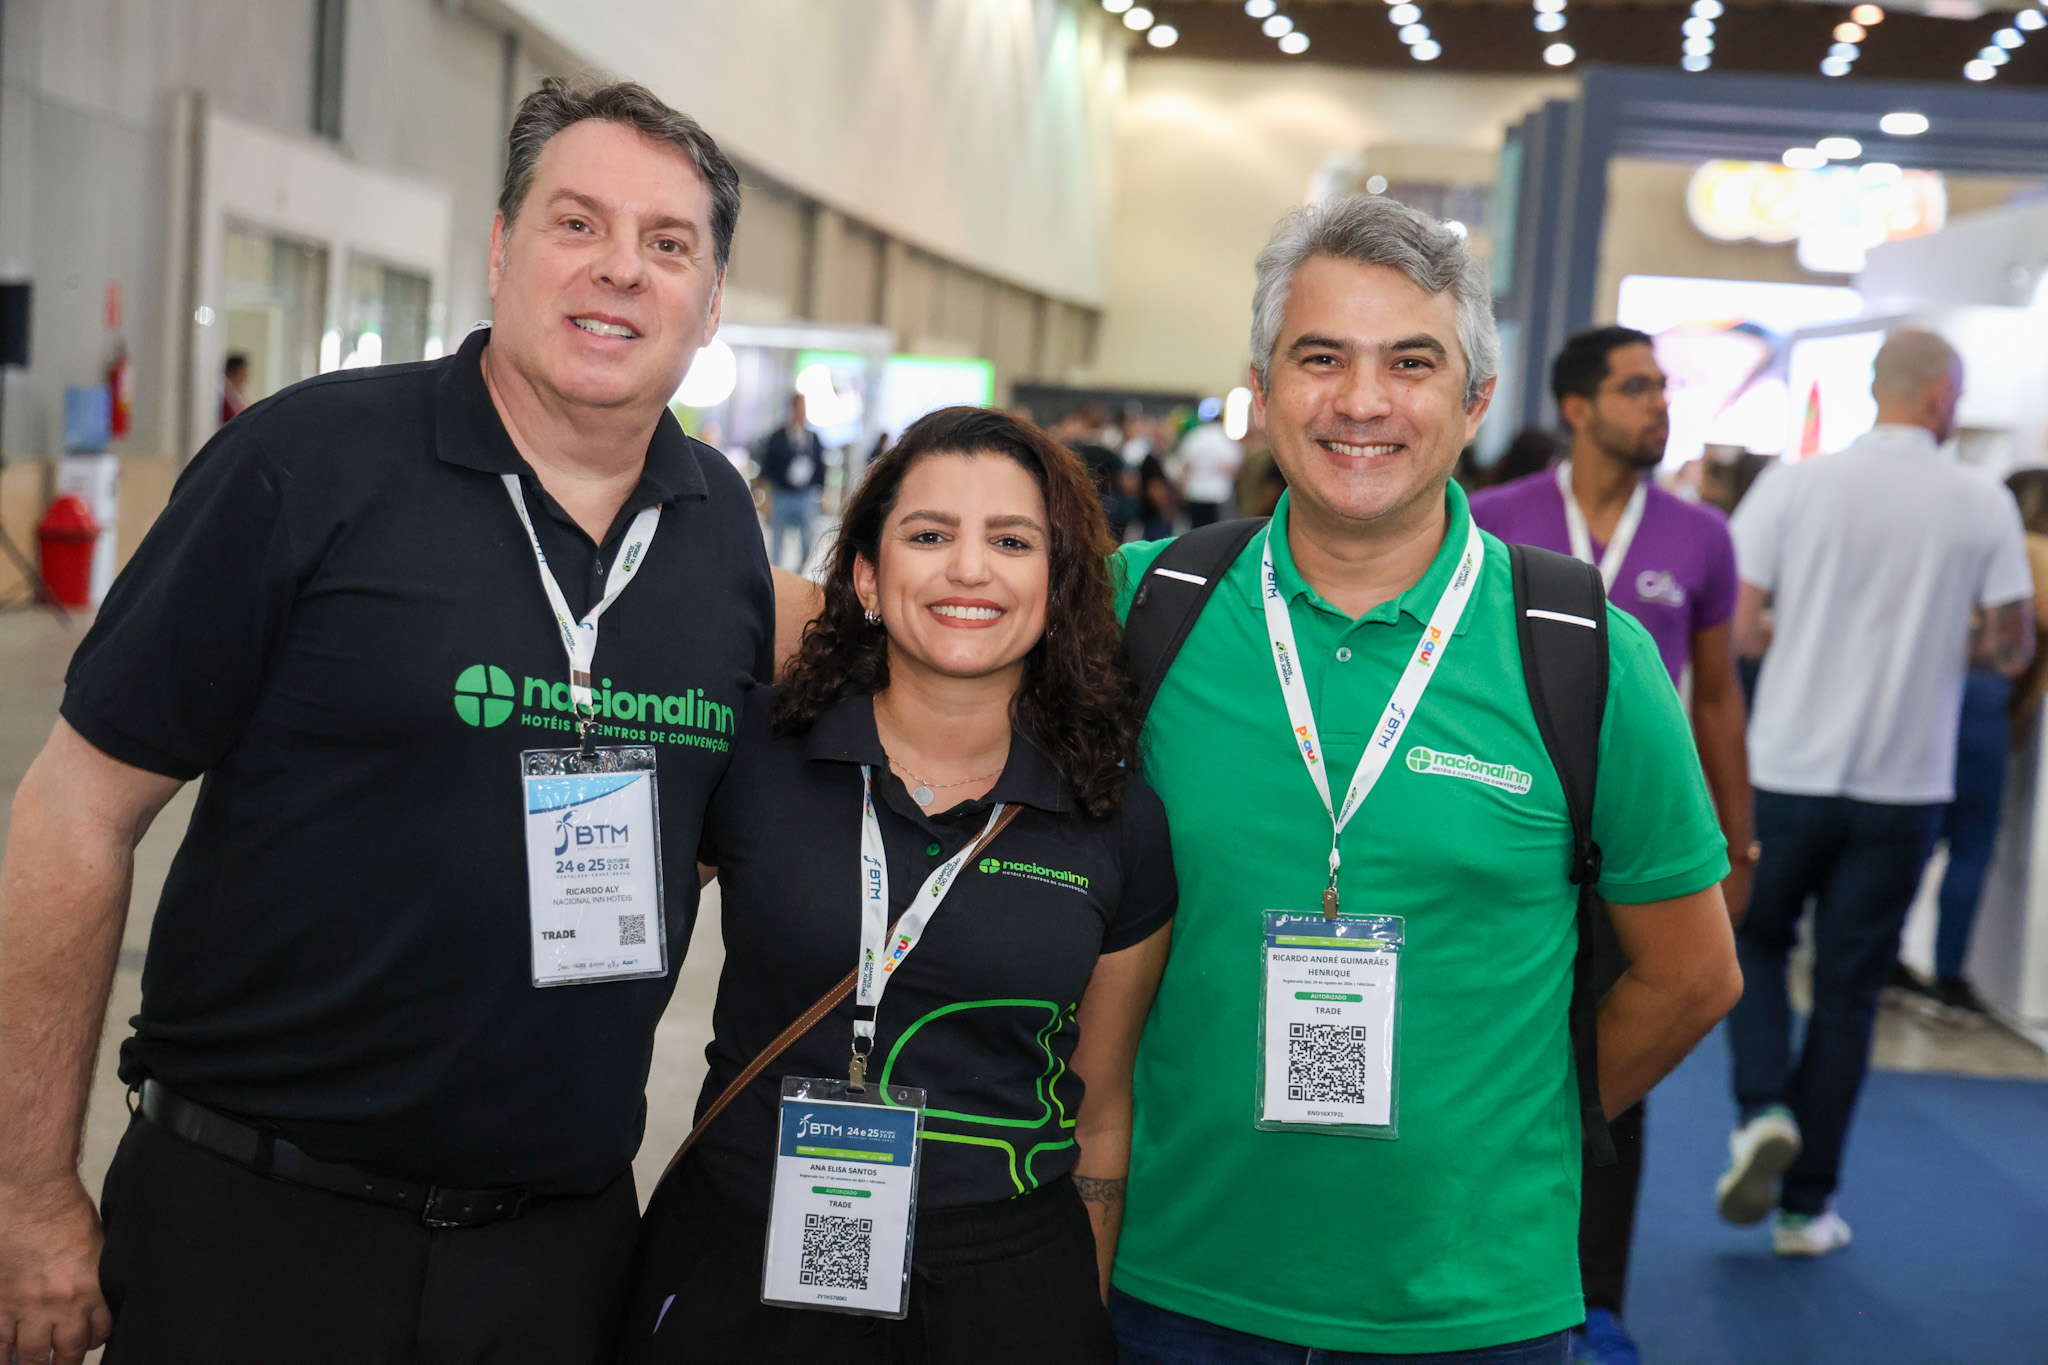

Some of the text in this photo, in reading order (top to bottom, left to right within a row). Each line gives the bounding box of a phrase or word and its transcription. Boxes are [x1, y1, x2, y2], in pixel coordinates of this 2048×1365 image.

[562, 622, 576, 646] CAMPOS
[1284, 652, 1293, 676] CAMPOS
[522, 713, 571, 732] HOTÉIS
[597, 724, 646, 741] ENTROS
[650, 730, 666, 743] DE
[668, 732, 730, 753] CONVENÇÕES
[1378, 717, 1400, 748] BTM
[1434, 754, 1530, 785] nacionalinn
[1432, 766, 1452, 774] HOTÉIS
[1457, 771, 1482, 780] CENTROS
[1491, 779, 1528, 792] CONVENÇÕES
[576, 824, 628, 845] BTM
[556, 858, 606, 873] 24 e 25
[935, 862, 952, 884] CAMPOS
[940, 858, 961, 886] DO JORDÃO
[1002, 870, 1021, 878] HOTÉIS
[1026, 874, 1050, 884] CENTROS
[1003, 860, 1089, 888] nacionalinn
[566, 887, 603, 896] RICARDO
[870, 868, 880, 900] BTM
[553, 898, 591, 906] NACIONAL
[592, 896, 605, 904] INN
[542, 930, 576, 940] TRADE
[1272, 954, 1389, 966] RICARDO ANDRÉ GUIMARÃES
[1308, 968, 1350, 978] HENRIQUE
[1316, 1006, 1342, 1014] TRADE
[810, 1122, 842, 1136] BTM
[847, 1126, 859, 1136] 24
[867, 1128, 880, 1138] 25
[810, 1164, 826, 1172] ANA
[848, 1168, 877, 1176] SANTOS
[826, 1188, 858, 1196] AUTORIZADO
[829, 1200, 852, 1208] TRADE
